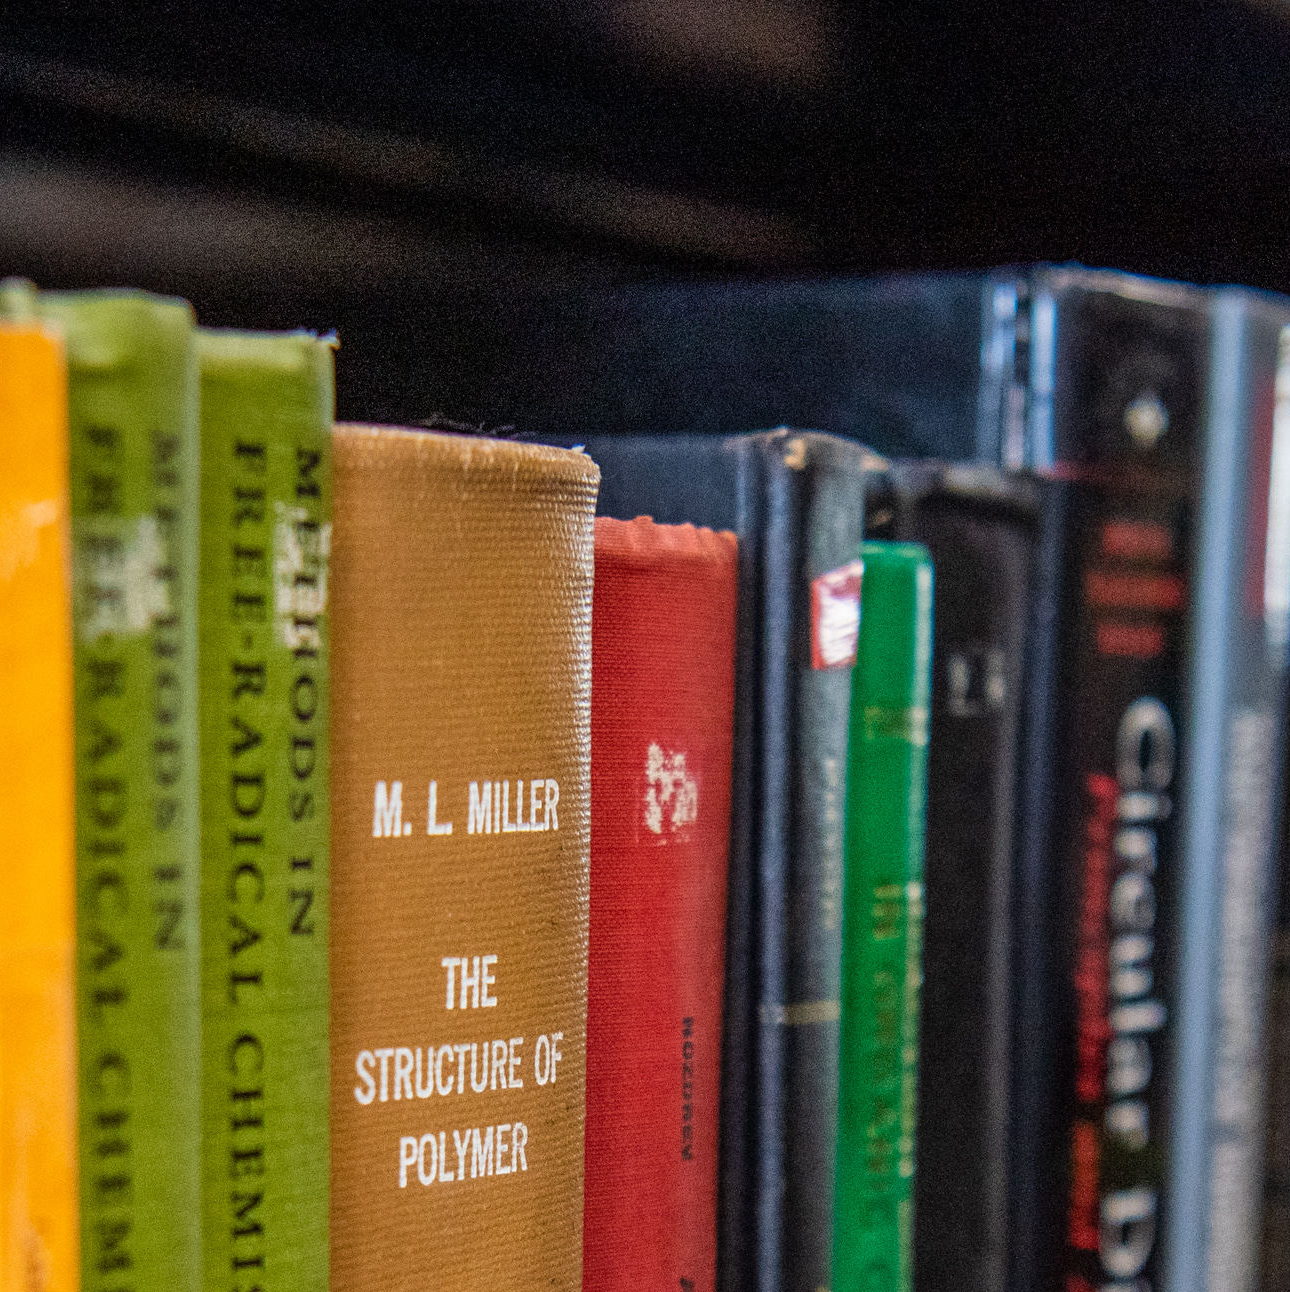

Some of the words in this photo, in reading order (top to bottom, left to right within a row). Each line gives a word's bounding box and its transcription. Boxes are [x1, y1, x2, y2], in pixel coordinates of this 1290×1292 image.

[289, 449, 323, 822] METHODS
[228, 439, 267, 1007] FREE-RADICAL
[372, 780, 412, 837] M.
[427, 779, 453, 835] L.
[467, 778, 560, 834] MILLER
[153, 865, 187, 951] IN
[289, 856, 317, 938] IN
[1106, 698, 1176, 1150] Circular
[441, 954, 498, 1010] THE
[354, 1037, 524, 1105] STRUCTURE
[534, 1031, 564, 1086] OF
[399, 1122, 528, 1188] POLYMER
